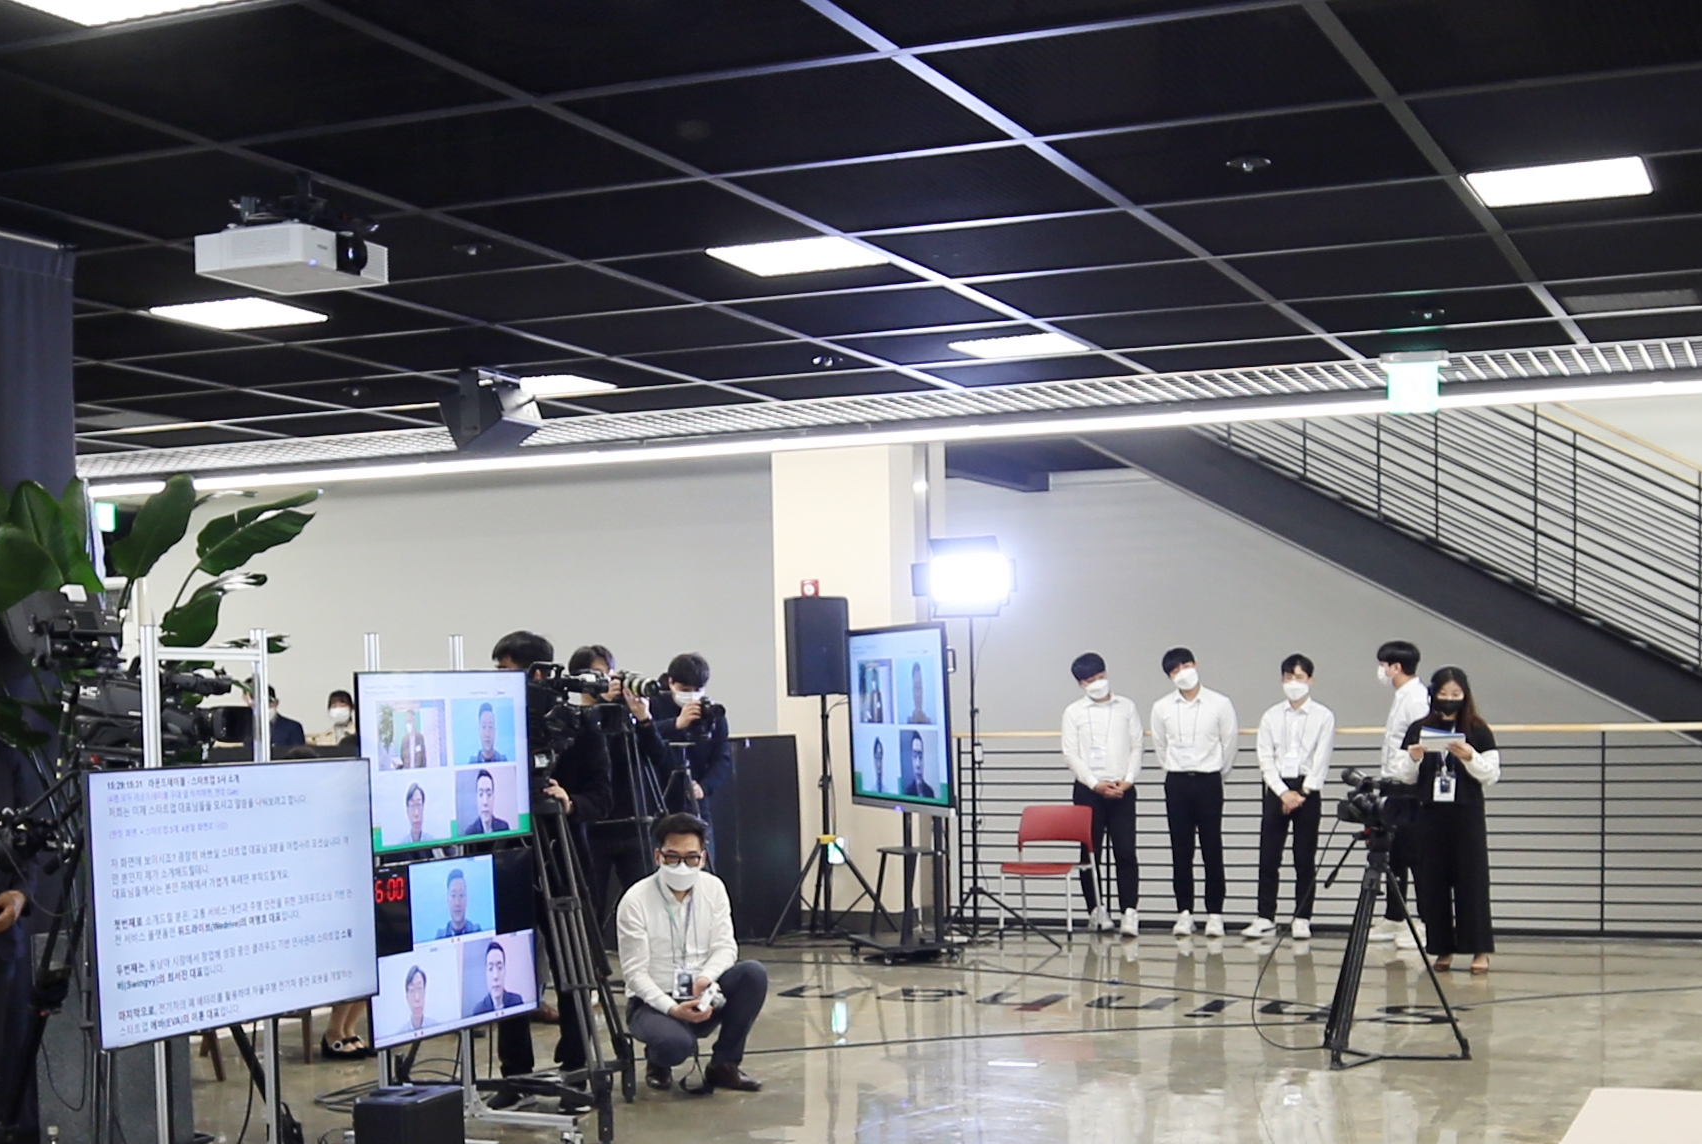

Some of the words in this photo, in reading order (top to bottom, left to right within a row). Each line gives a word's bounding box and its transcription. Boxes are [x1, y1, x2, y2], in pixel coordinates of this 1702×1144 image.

[109, 805, 130, 818] 저희는
[132, 804, 147, 816] 이제
[148, 802, 177, 815] 스타트업
[179, 800, 211, 813] 대표님들을
[120, 856, 142, 868] 화면에
[221, 845, 247, 858] 스타트업
[248, 843, 268, 856] 대표님
[144, 868, 159, 881] 제가
[112, 884, 162, 900] 대표님들께서는
[208, 905, 228, 917] 서비스
[124, 932, 146, 944] 서비스
[189, 964, 224, 978] 대표입니다.
[119, 1021, 148, 1037] 스타트업
[206, 1004, 240, 1020] 대표입니다.
